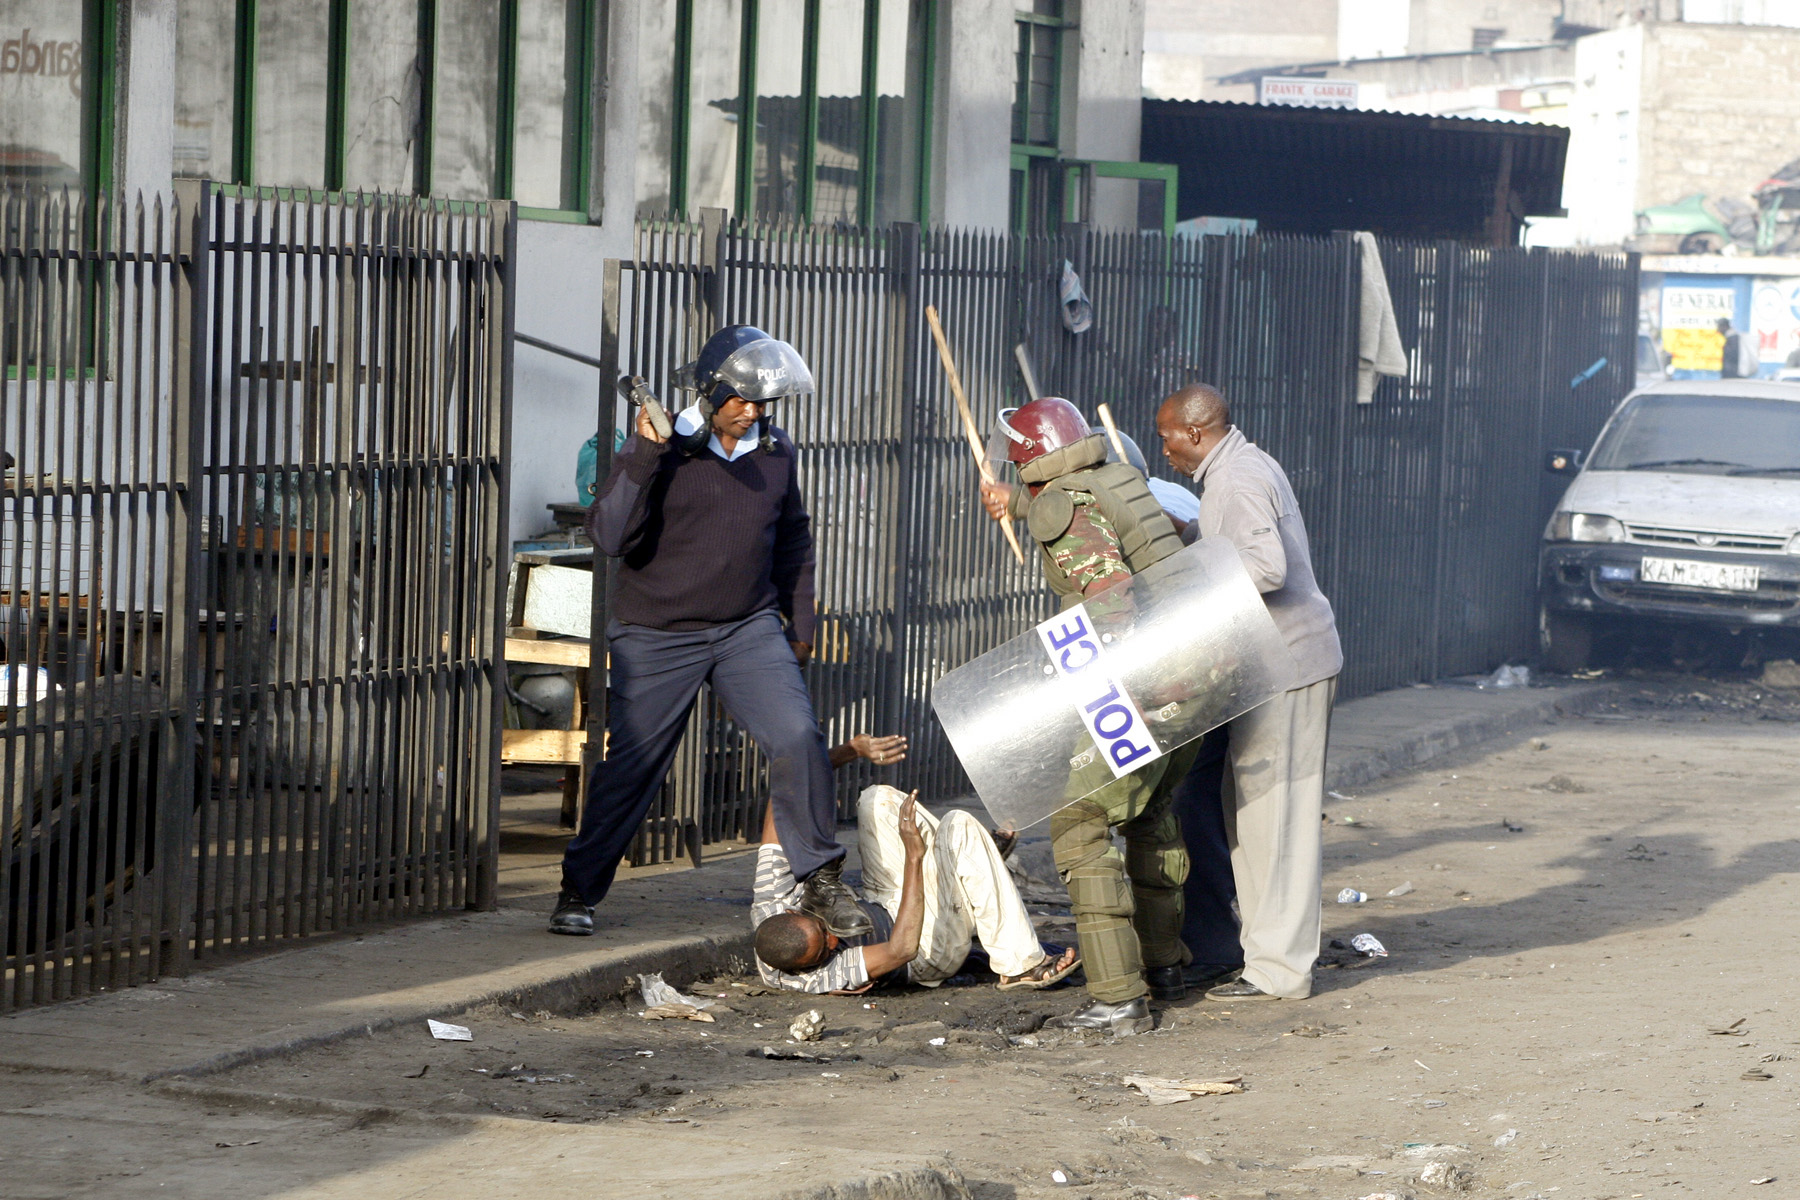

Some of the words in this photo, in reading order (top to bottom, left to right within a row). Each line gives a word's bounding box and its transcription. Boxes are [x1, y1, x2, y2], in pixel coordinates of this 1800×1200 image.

[1313, 86, 1353, 97] GARAGE
[757, 367, 787, 381] POLICE
[1047, 615, 1152, 768] POLCE
